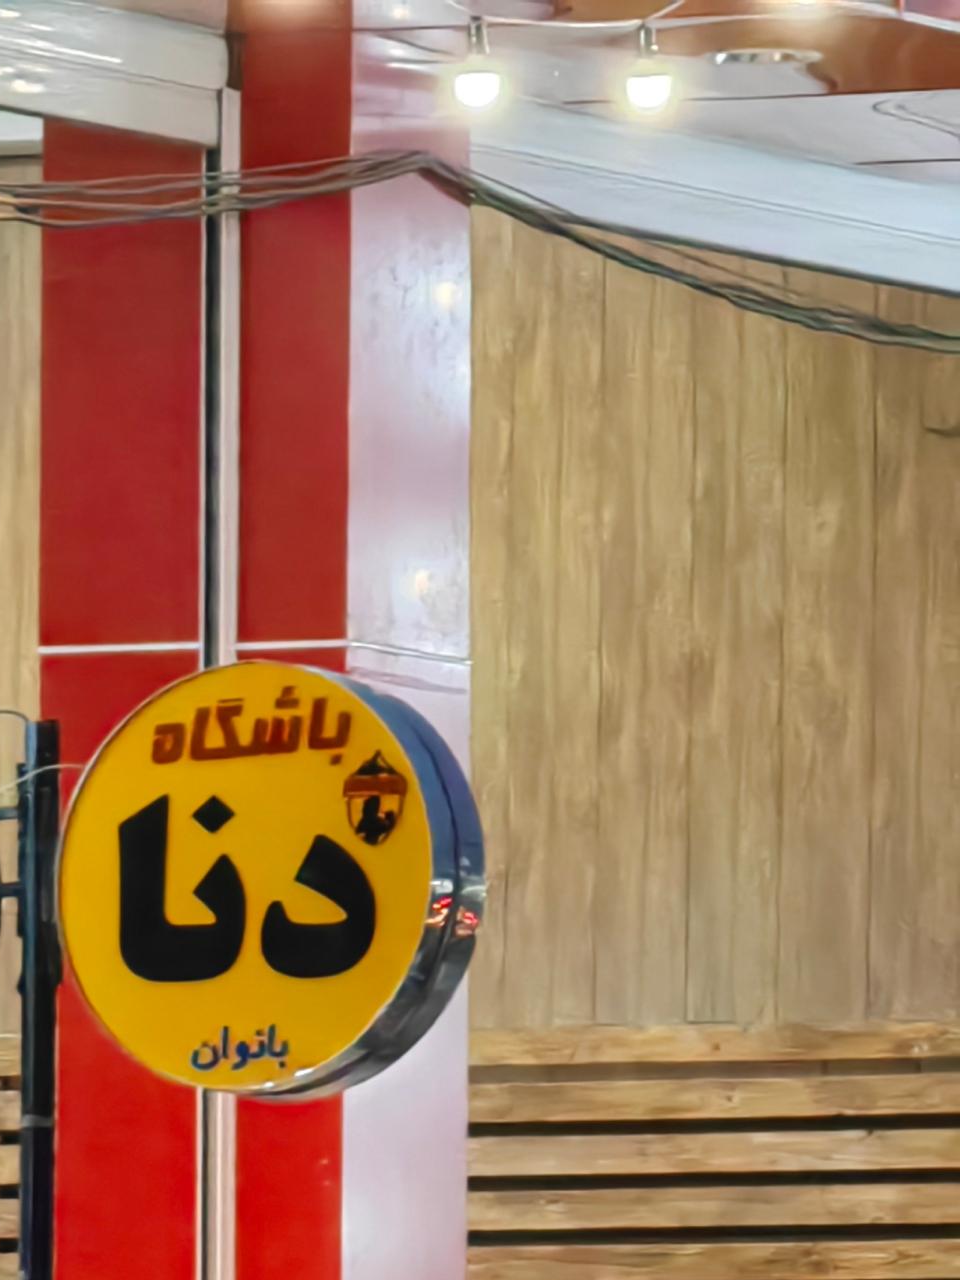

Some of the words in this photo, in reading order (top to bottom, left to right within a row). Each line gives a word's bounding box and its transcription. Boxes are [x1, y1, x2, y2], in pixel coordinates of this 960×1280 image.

[151, 686, 352, 766] باشگاه
[118, 794, 377, 983] دنا
[191, 1025, 290, 1071] بانوان
